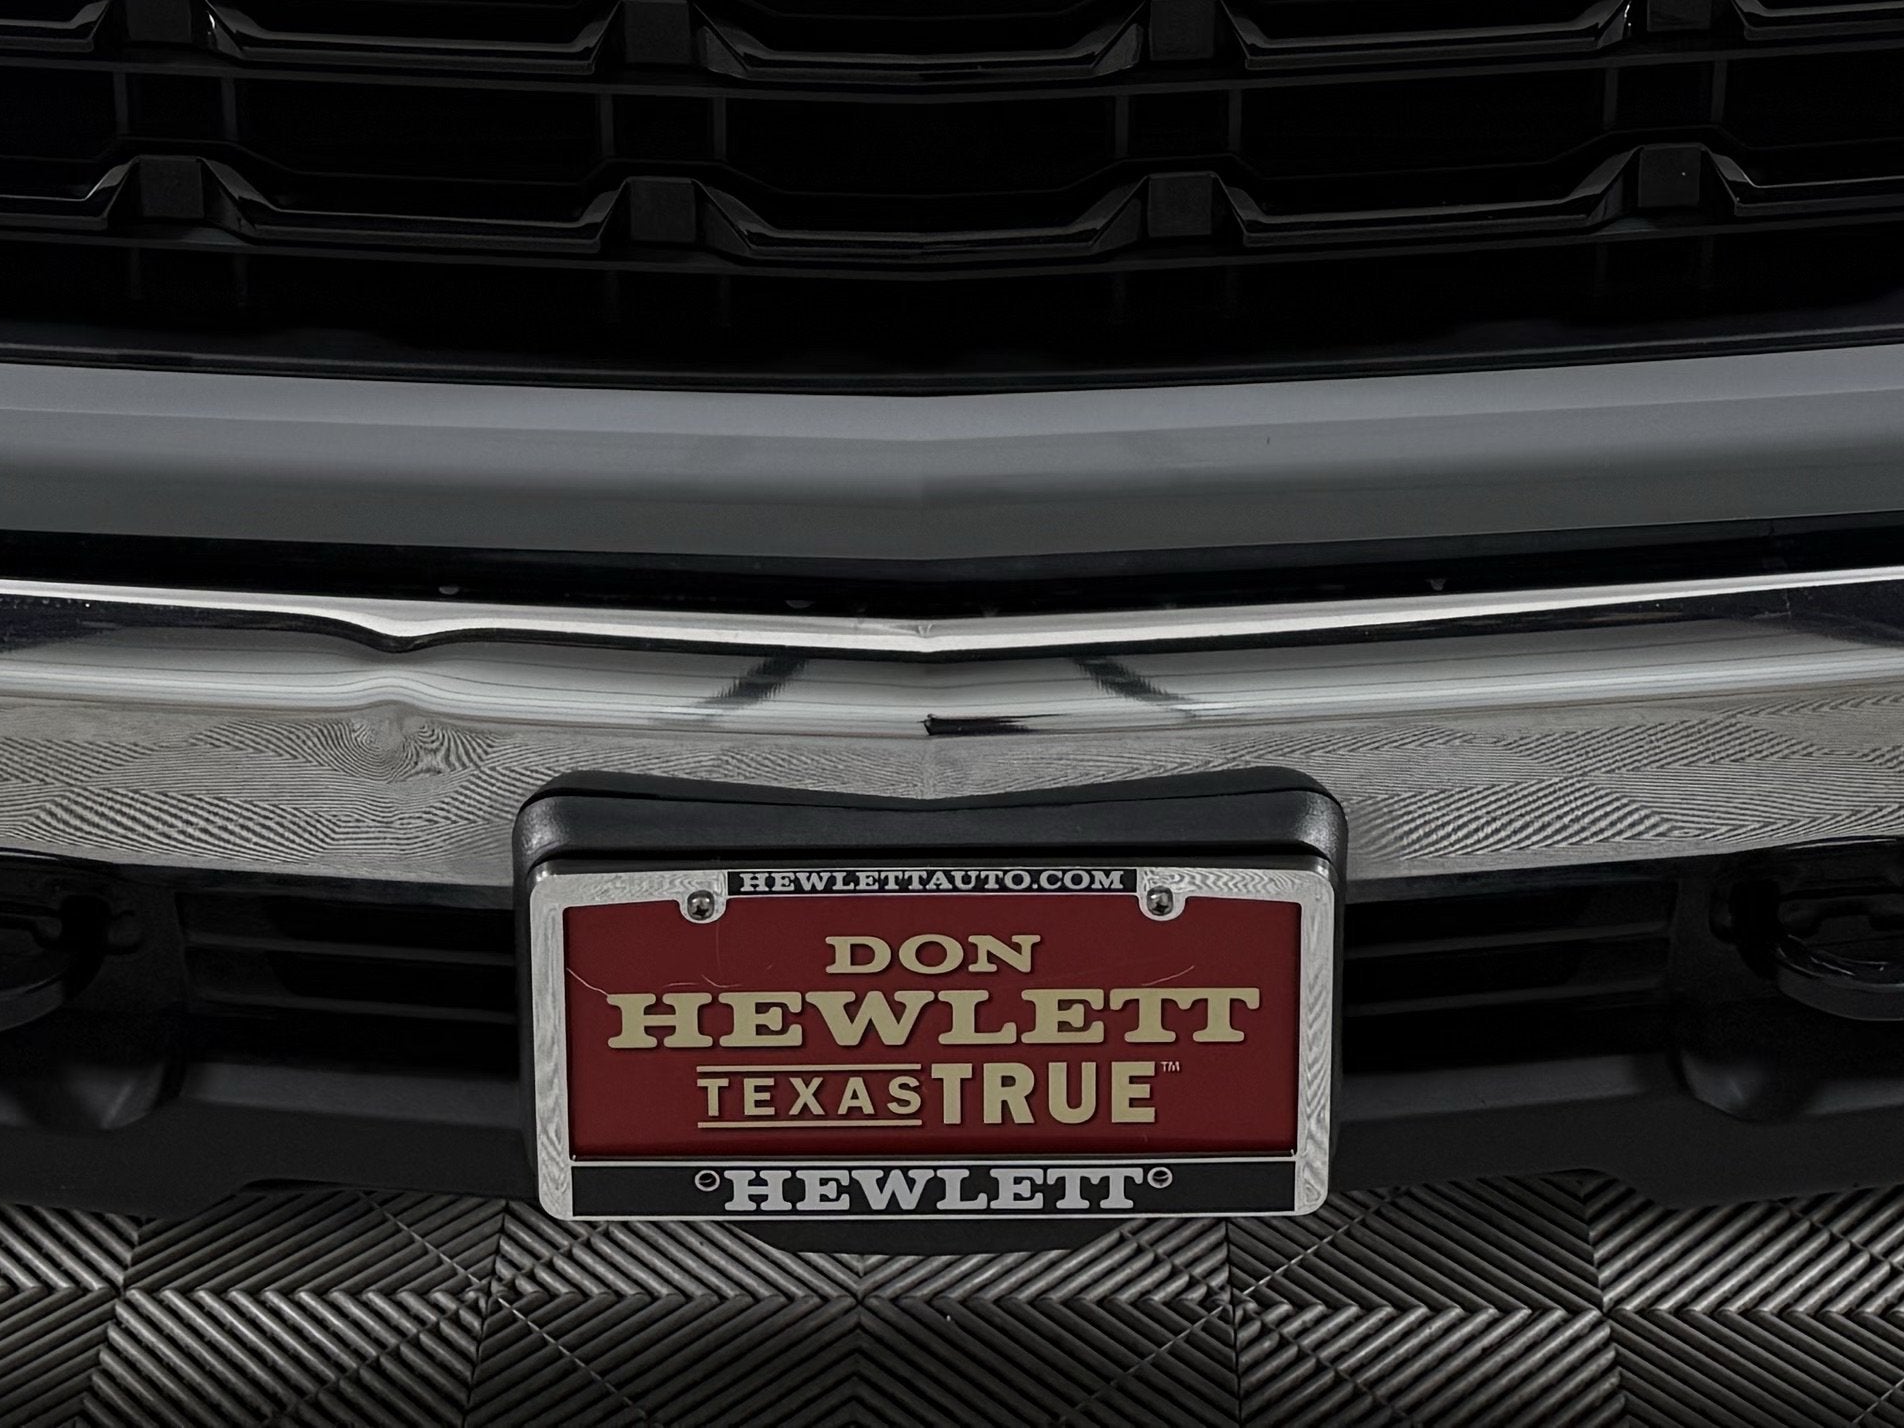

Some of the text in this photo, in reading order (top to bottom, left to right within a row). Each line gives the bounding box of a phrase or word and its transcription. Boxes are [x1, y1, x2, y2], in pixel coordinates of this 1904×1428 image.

[738, 868, 1125, 892] HEWLETTAUTO.COM
[825, 935, 1041, 975] DON
[606, 987, 1260, 1049] HEWLETT
[723, 1166, 1145, 1212] HEWLETT
